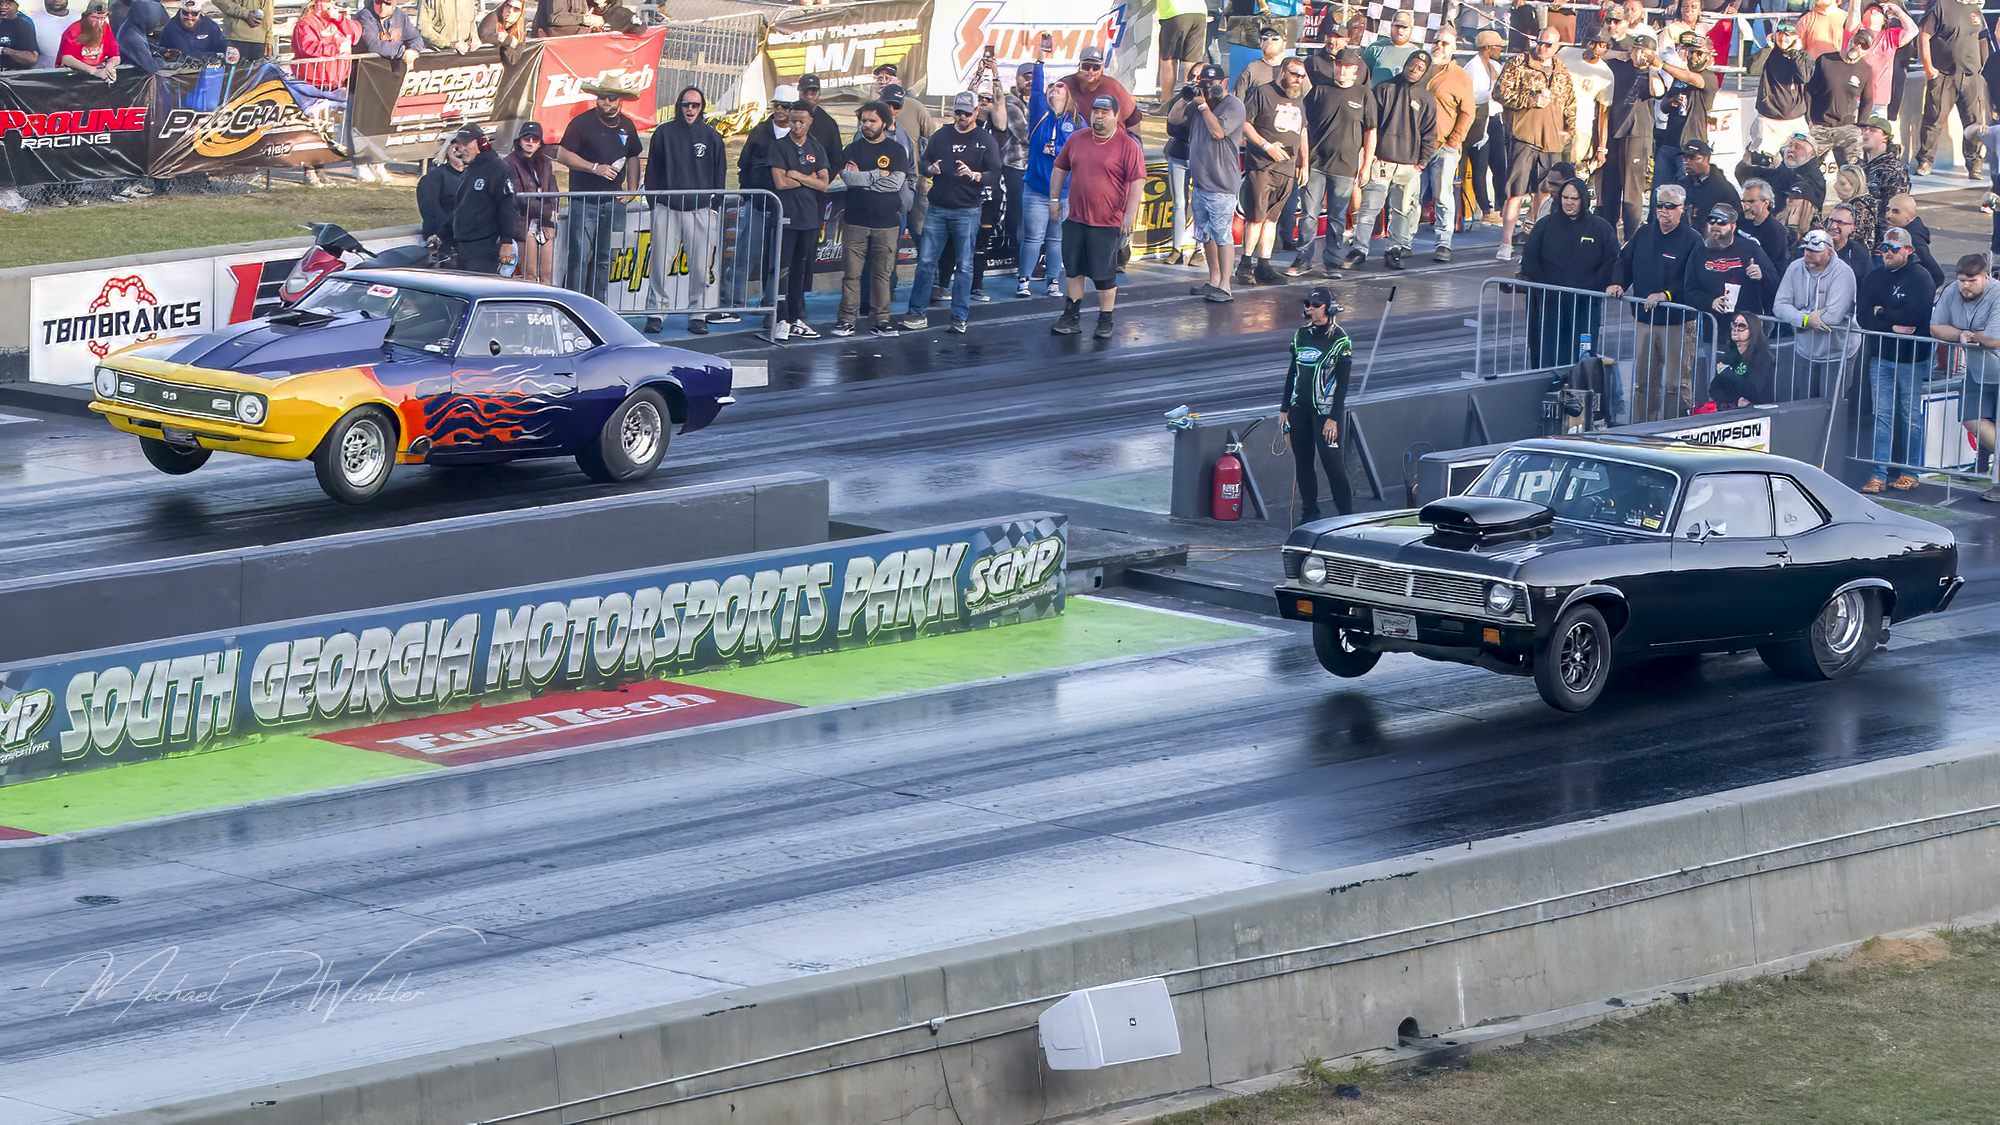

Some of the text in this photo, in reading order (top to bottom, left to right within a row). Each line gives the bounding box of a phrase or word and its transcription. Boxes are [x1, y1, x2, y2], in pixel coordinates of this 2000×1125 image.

[805, 39, 884, 74] M/T
[20, 133, 112, 149] RACING
[965, 536, 1067, 609] SGMP
[60, 542, 970, 760] SOUTH GEORGIA MOTORSPORTS PARK
[376, 692, 716, 753] FuelTech
